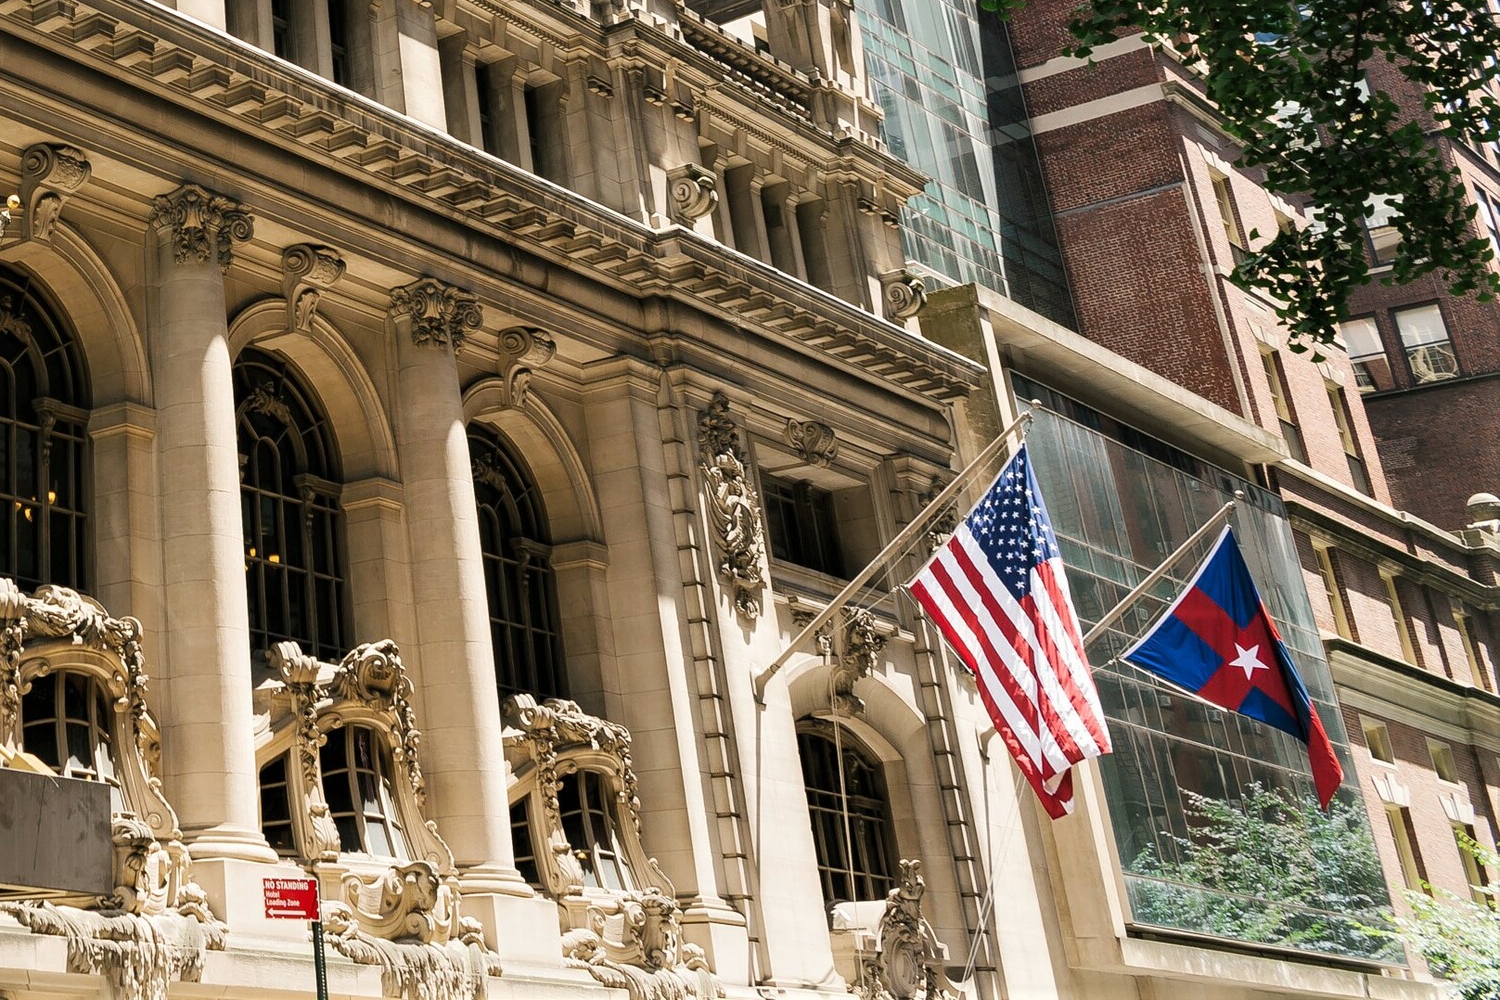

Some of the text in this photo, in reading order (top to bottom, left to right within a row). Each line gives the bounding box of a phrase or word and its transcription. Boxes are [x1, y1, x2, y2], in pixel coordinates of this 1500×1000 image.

[264, 880, 309, 891] NO STANDING
[265, 890, 280, 898] Hotel
[266, 899, 300, 907] Loading Zone
